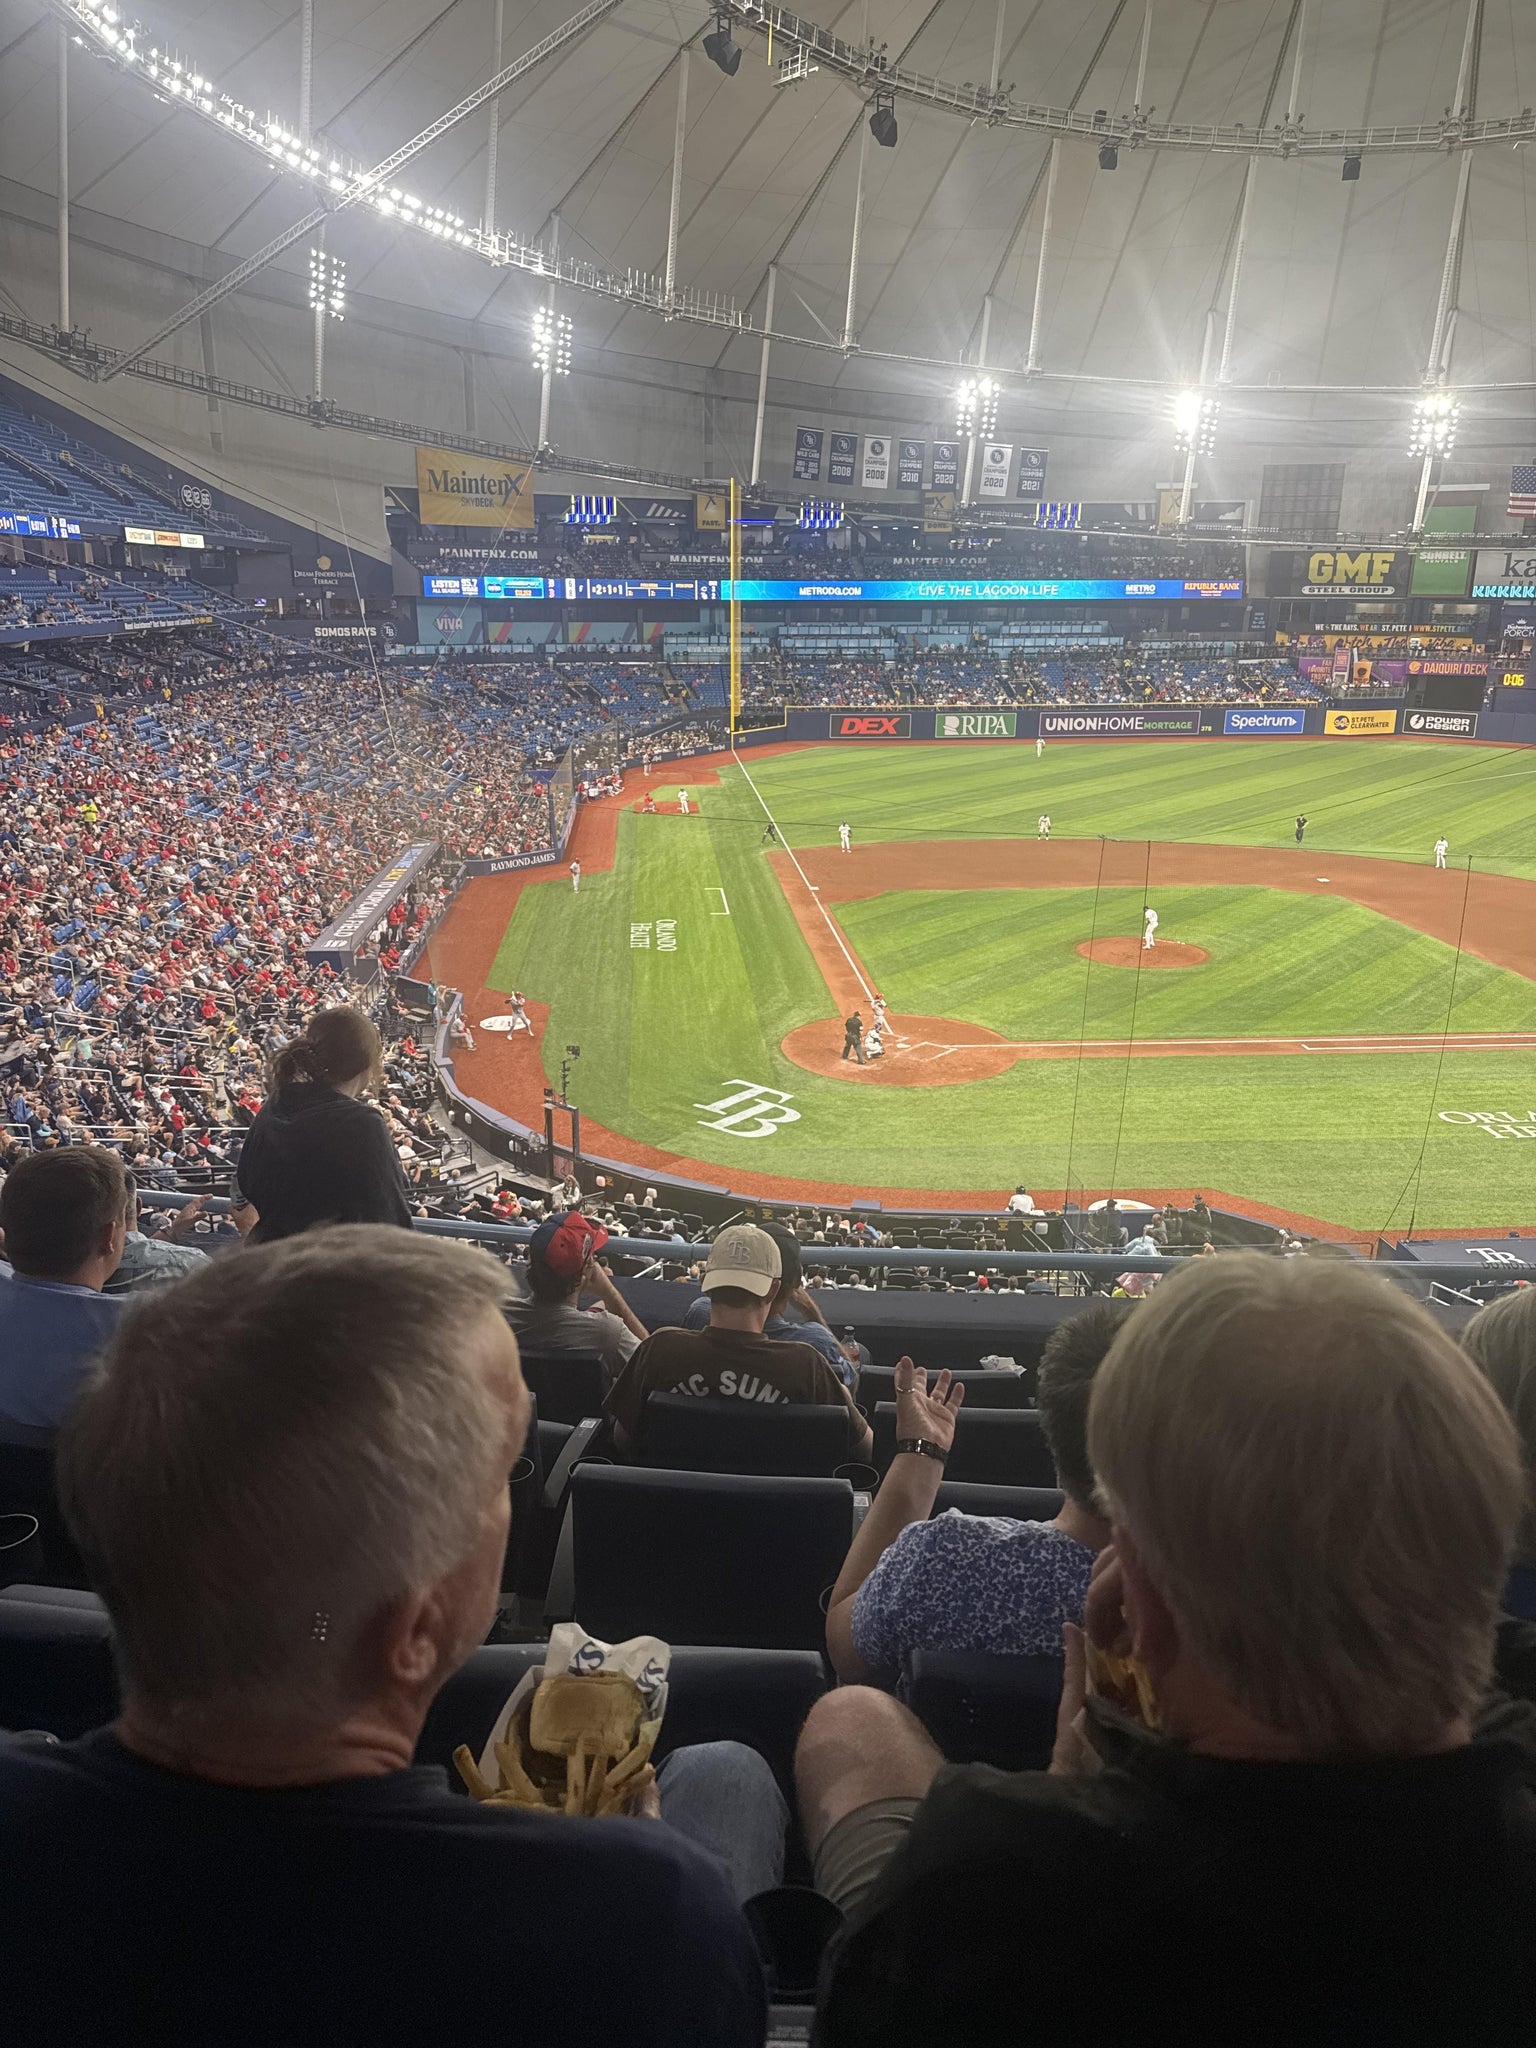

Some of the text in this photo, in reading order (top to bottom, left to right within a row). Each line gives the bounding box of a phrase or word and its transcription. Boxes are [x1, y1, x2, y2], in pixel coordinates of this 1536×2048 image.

[831, 465, 851, 477] 2008
[865, 469, 885, 480] 2008
[901, 472, 919, 483] 2010
[935, 474, 954, 484] 2020
[983, 477, 1004, 488] 2020
[427, 468, 524, 506] MaintenX
[1021, 480, 1040, 491] 2021
[440, 548, 538, 559] MAINTENX.COM
[294, 570, 314, 578] DREAM
[1308, 552, 1395, 584] GMF
[313, 577, 338, 585] TERRACE
[431, 580, 460, 588] LISTEN
[799, 587, 861, 596] METRODG.COM
[919, 585, 1059, 596] LIVE THE LAGOON LIFE
[1125, 584, 1156, 592] METRO
[436, 618, 463, 630] VIVA
[1503, 629, 1535, 637] PORCH
[1423, 663, 1488, 675] DAIQUIRI DECK
[840, 718, 901, 734] DEX
[961, 716, 1008, 735] RIPA
[1144, 721, 1193, 729] MORTGAGE
[1230, 714, 1292, 731] Spectrum
[490, 853, 556, 872] RAYMOND JAMES
[349, 888, 391, 919] TROPICANA
[333, 916, 364, 938] FIELD
[630, 922, 652, 949] HEALTH
[657, 918, 677, 952] ORLANDO
[693, 1078, 802, 1137] TB
[728, 1240, 751, 1264] TB
